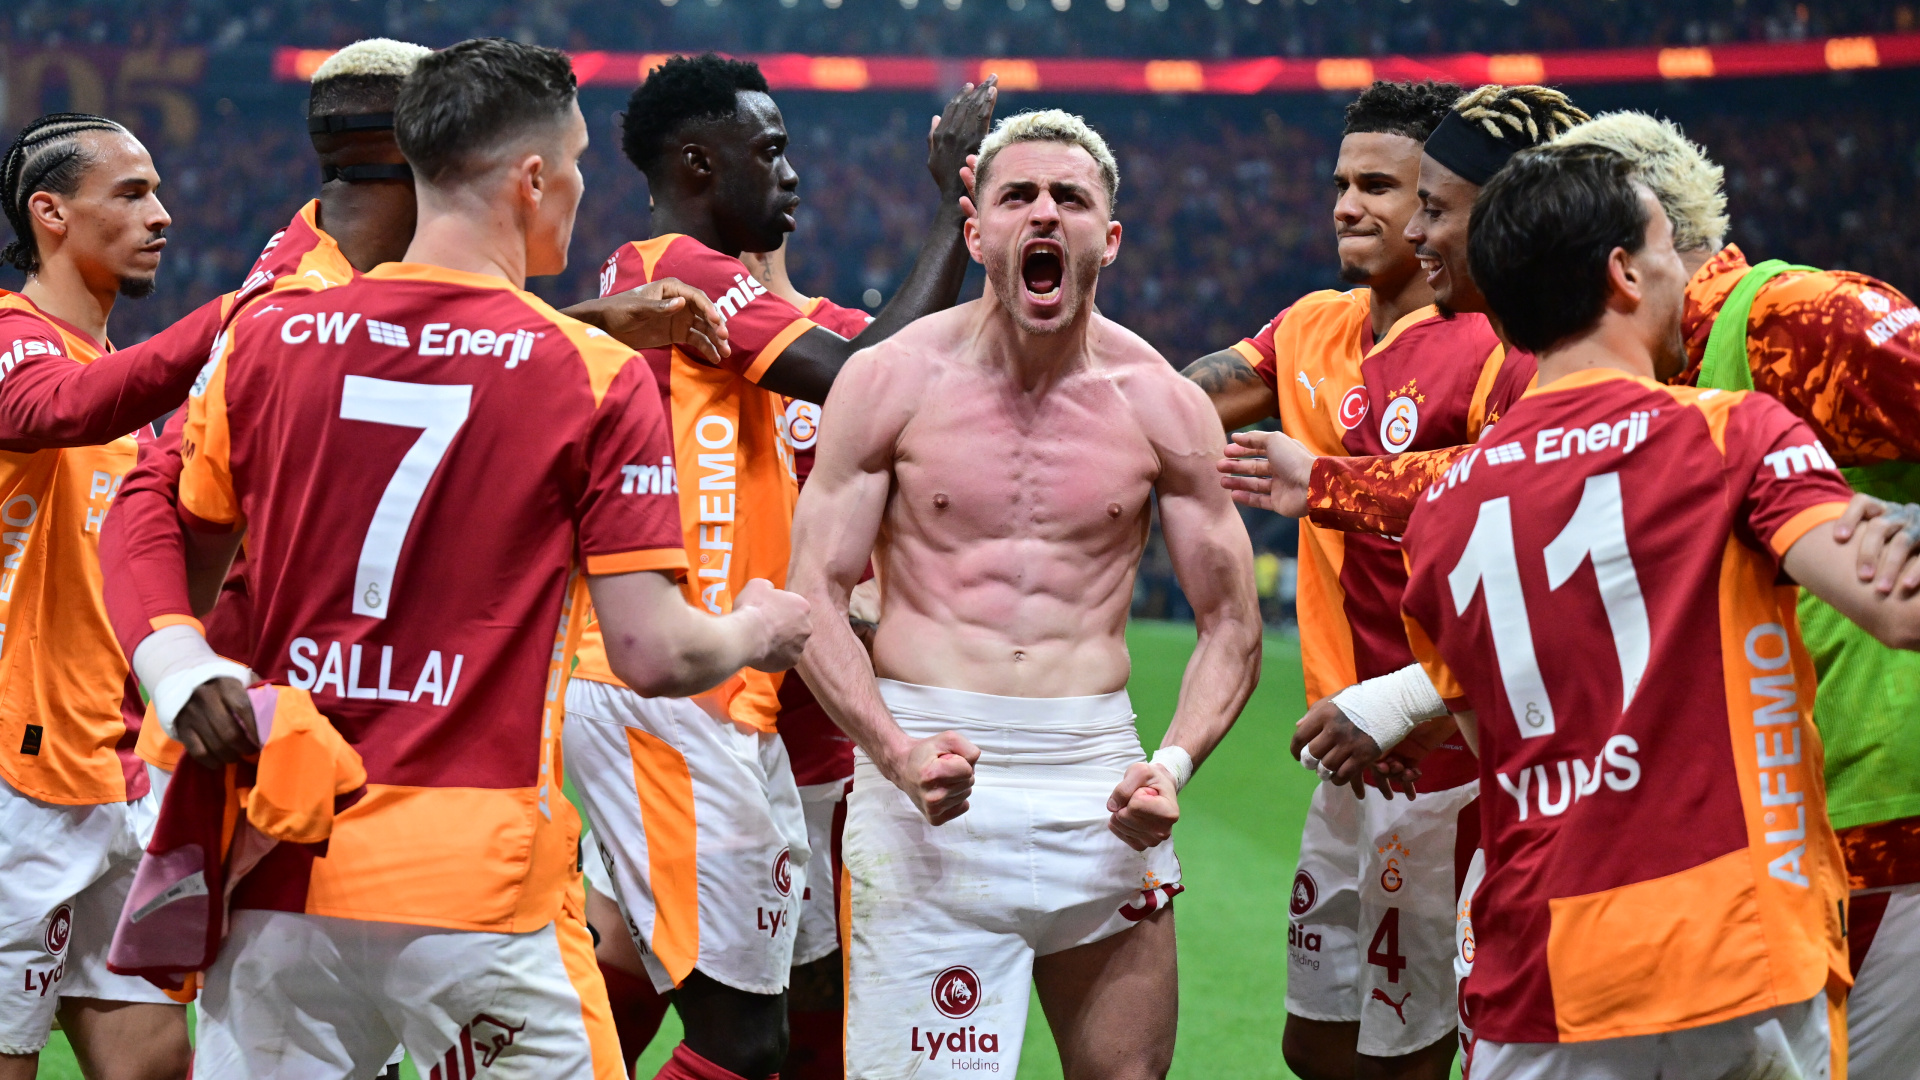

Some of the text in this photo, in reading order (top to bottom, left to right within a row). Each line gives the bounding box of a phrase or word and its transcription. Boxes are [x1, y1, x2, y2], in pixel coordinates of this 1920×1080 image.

[281, 312, 535, 369] CW Enerji
[1535, 411, 1650, 464] Enerji
[340, 375, 473, 619] 7
[696, 415, 736, 614] ALFEMO
[1448, 472, 1651, 739] 11
[287, 637, 464, 707] SALLAI
[1744, 622, 1809, 888] ALFEMO
[1367, 907, 1407, 983] 4
[911, 1025, 999, 1061] Lydia
[951, 1058, 1000, 1073] Holding
